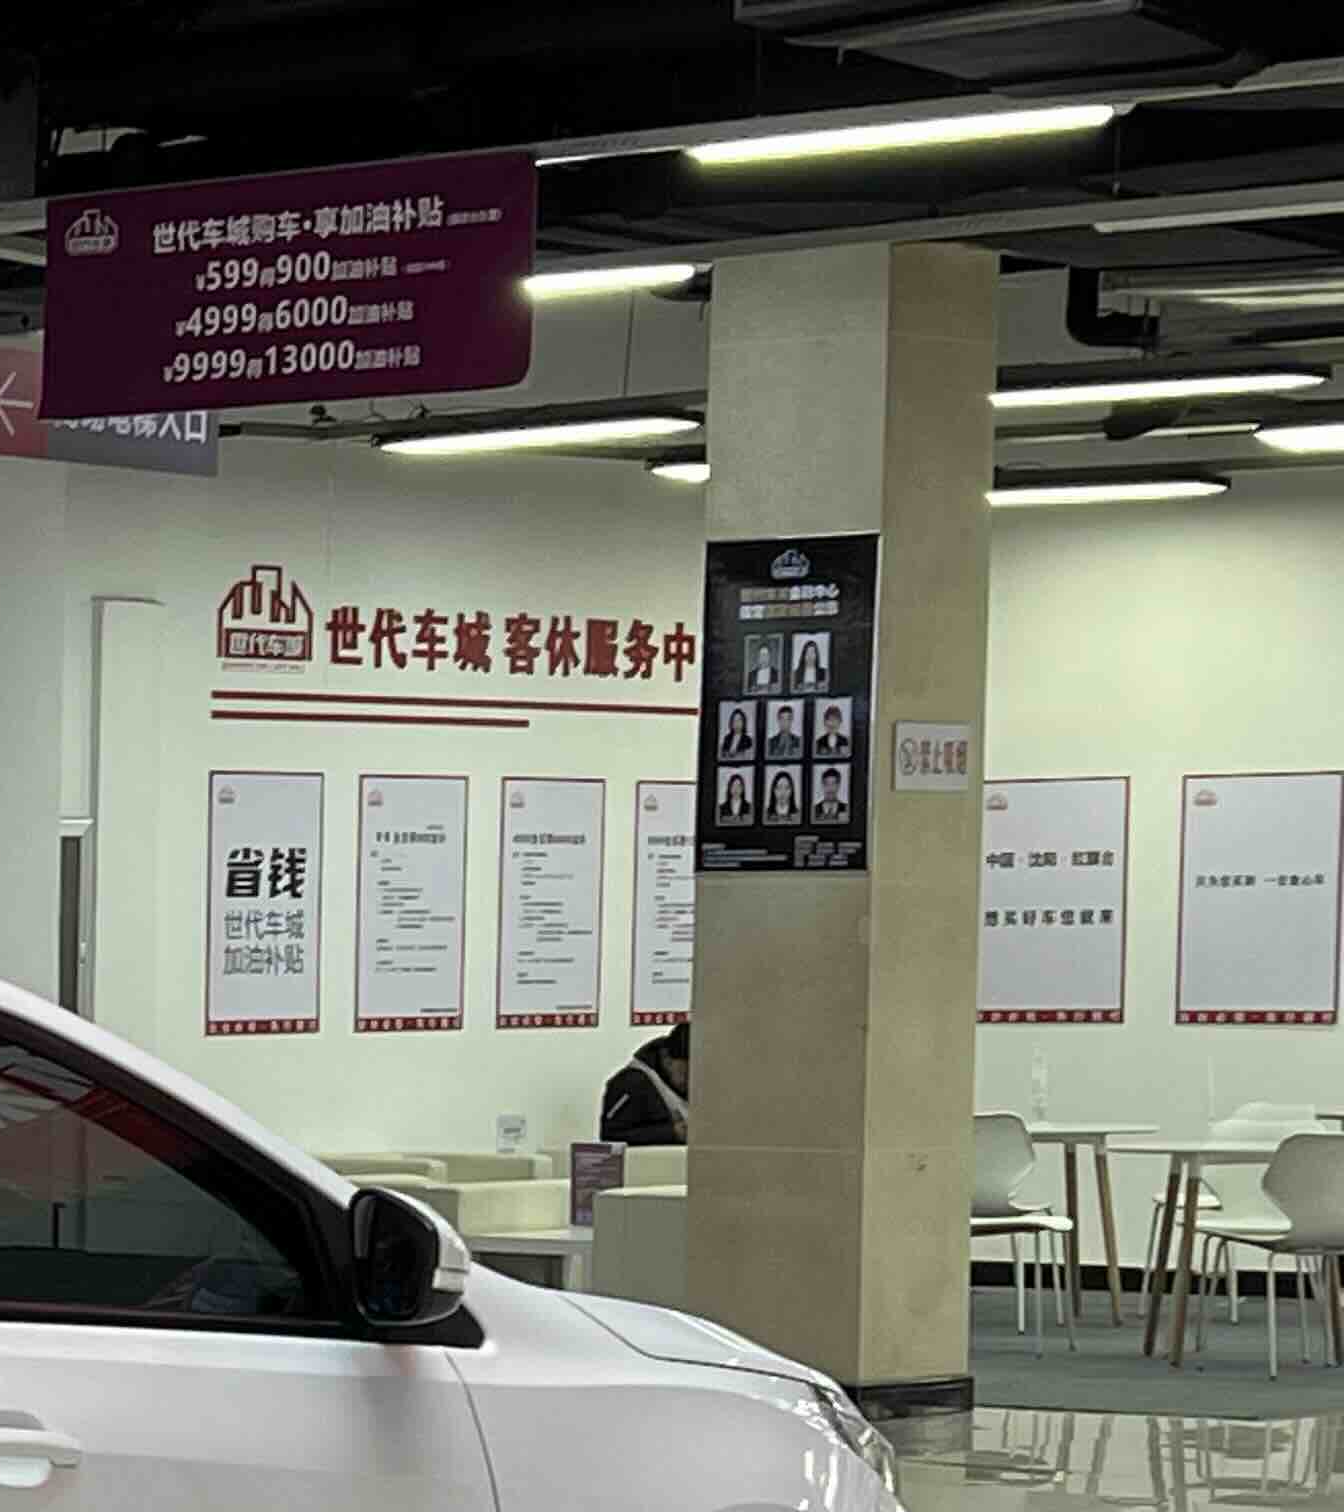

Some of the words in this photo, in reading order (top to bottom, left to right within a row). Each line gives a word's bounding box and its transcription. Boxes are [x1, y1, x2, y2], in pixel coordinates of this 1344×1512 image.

[324, 605, 493, 673] 世代车城
[225, 847, 307, 898] 省钱
[223, 908, 305, 941] 世代车城
